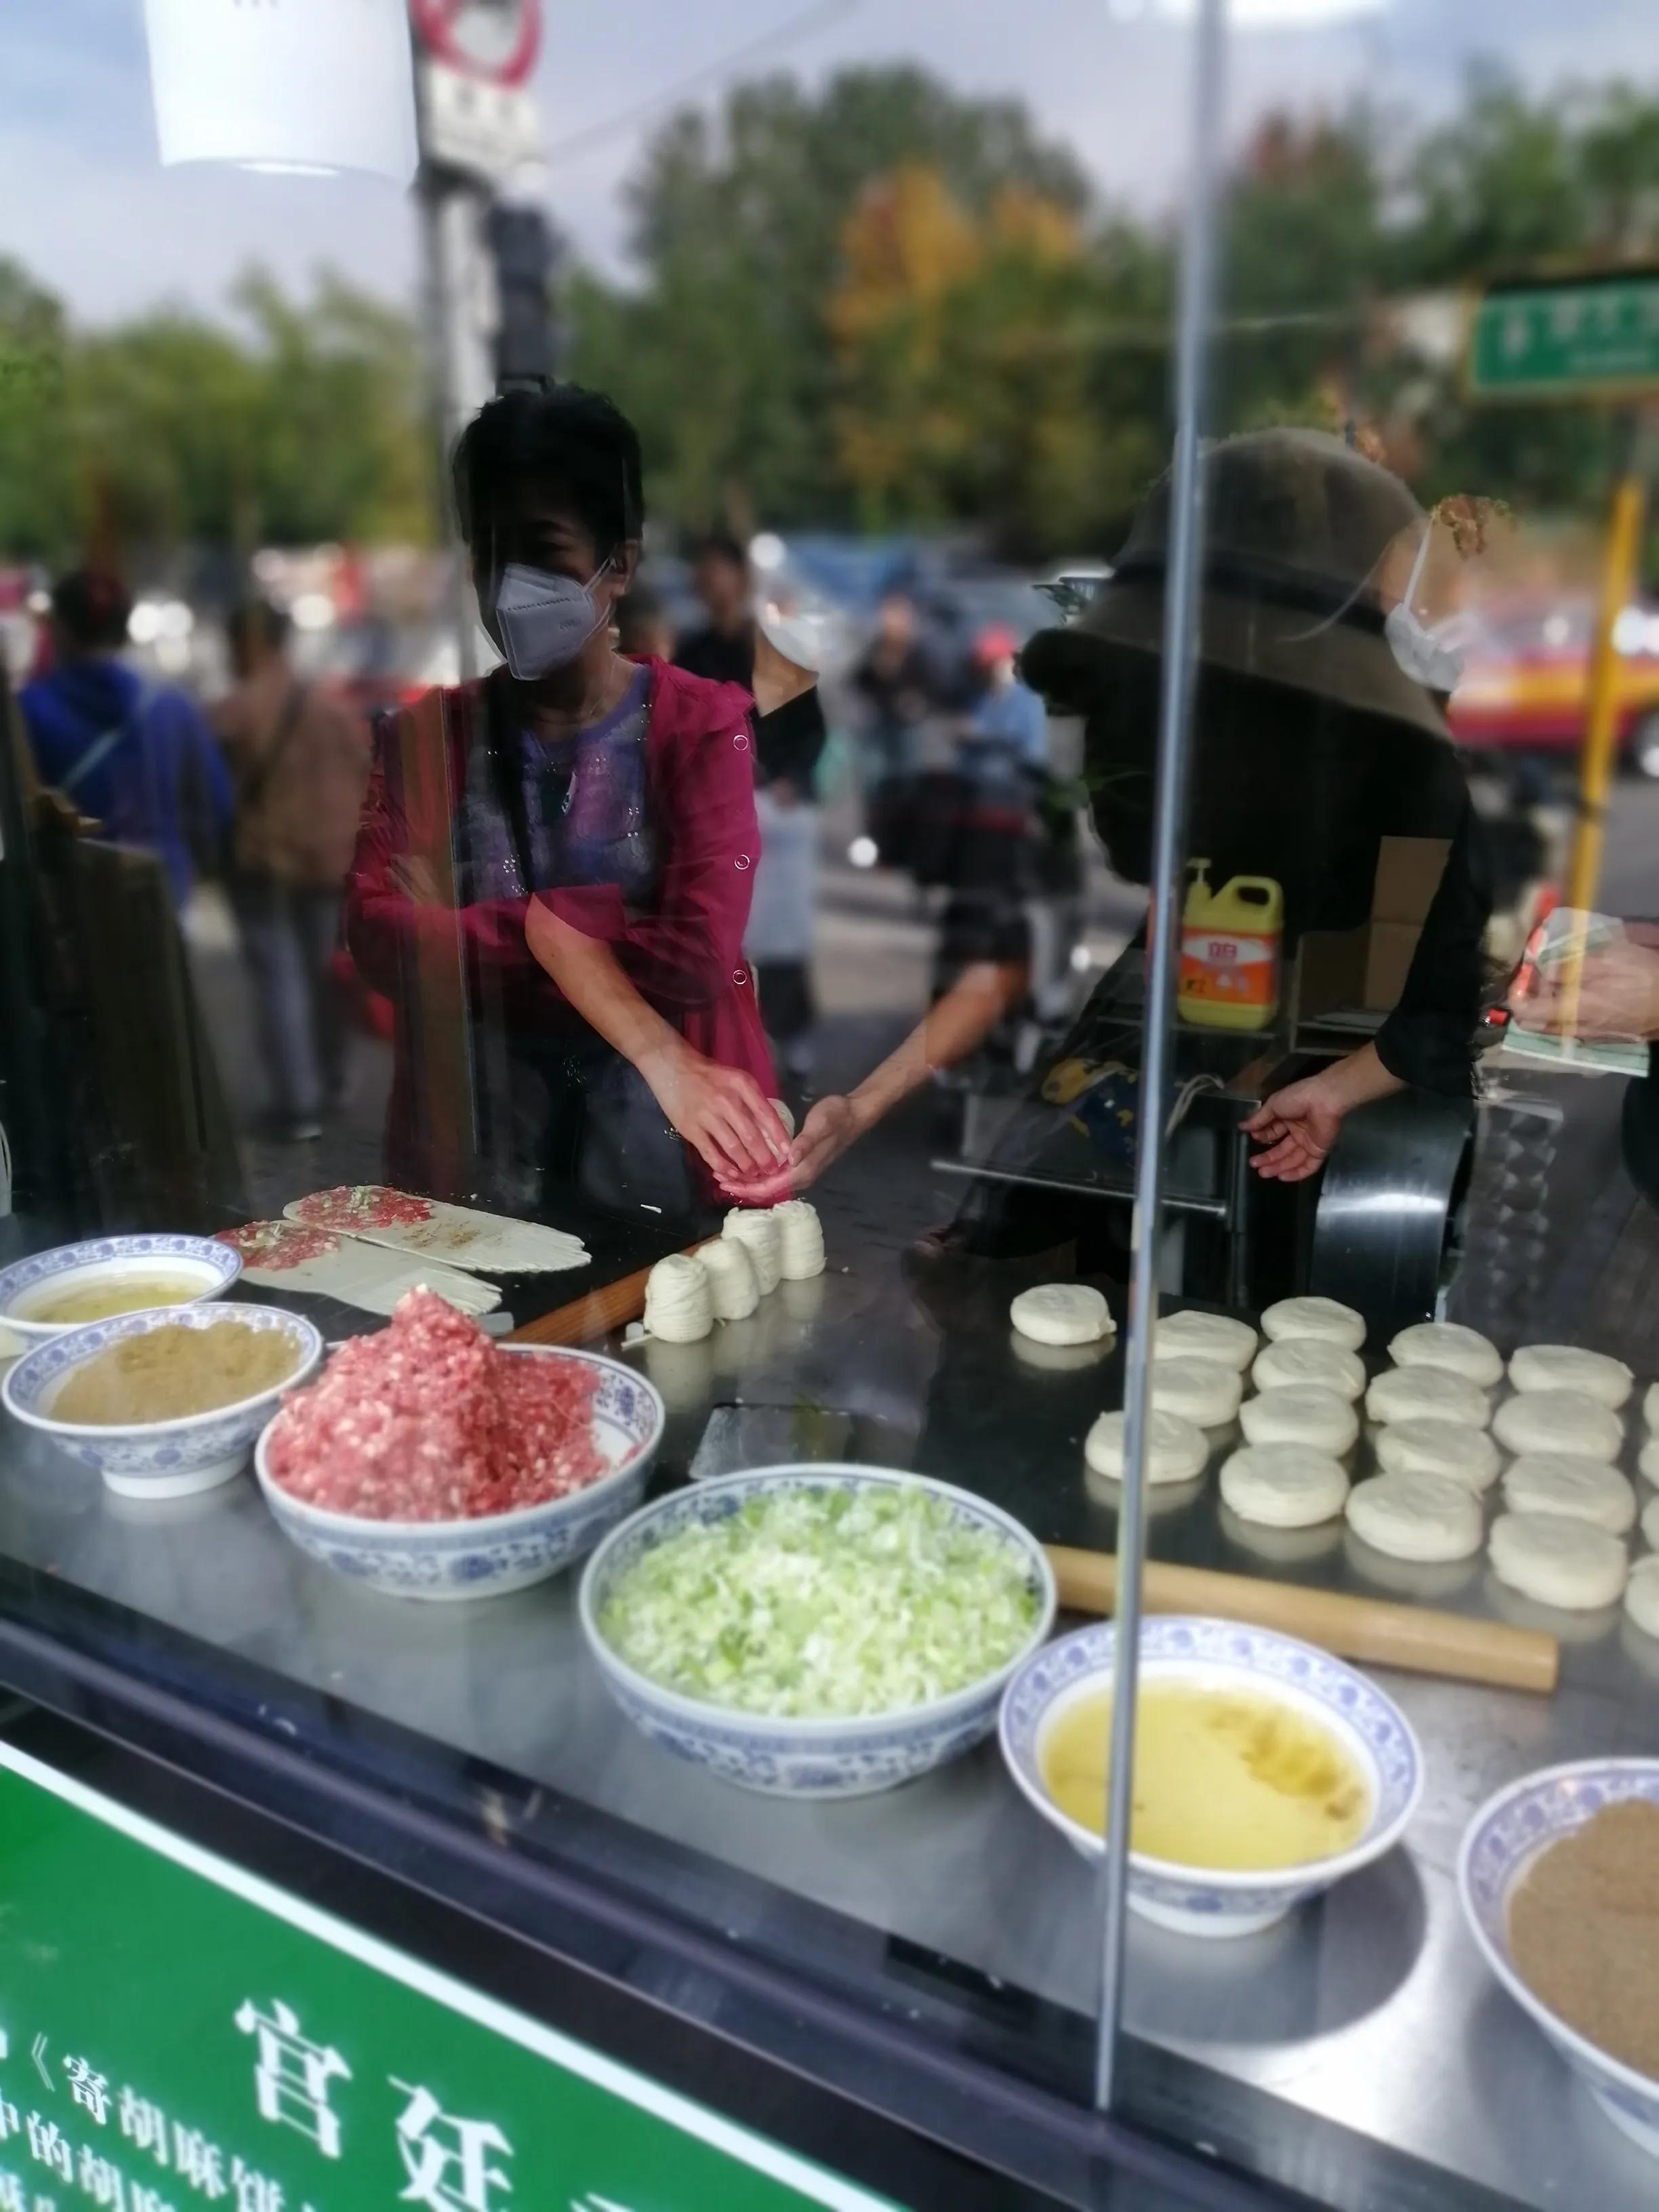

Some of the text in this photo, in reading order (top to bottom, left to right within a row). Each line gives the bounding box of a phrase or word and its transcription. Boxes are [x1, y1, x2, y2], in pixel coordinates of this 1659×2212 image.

[0, 2029, 316, 2212] 《寄胡麻饼
[234, 1998, 636, 2212] 宫廷
